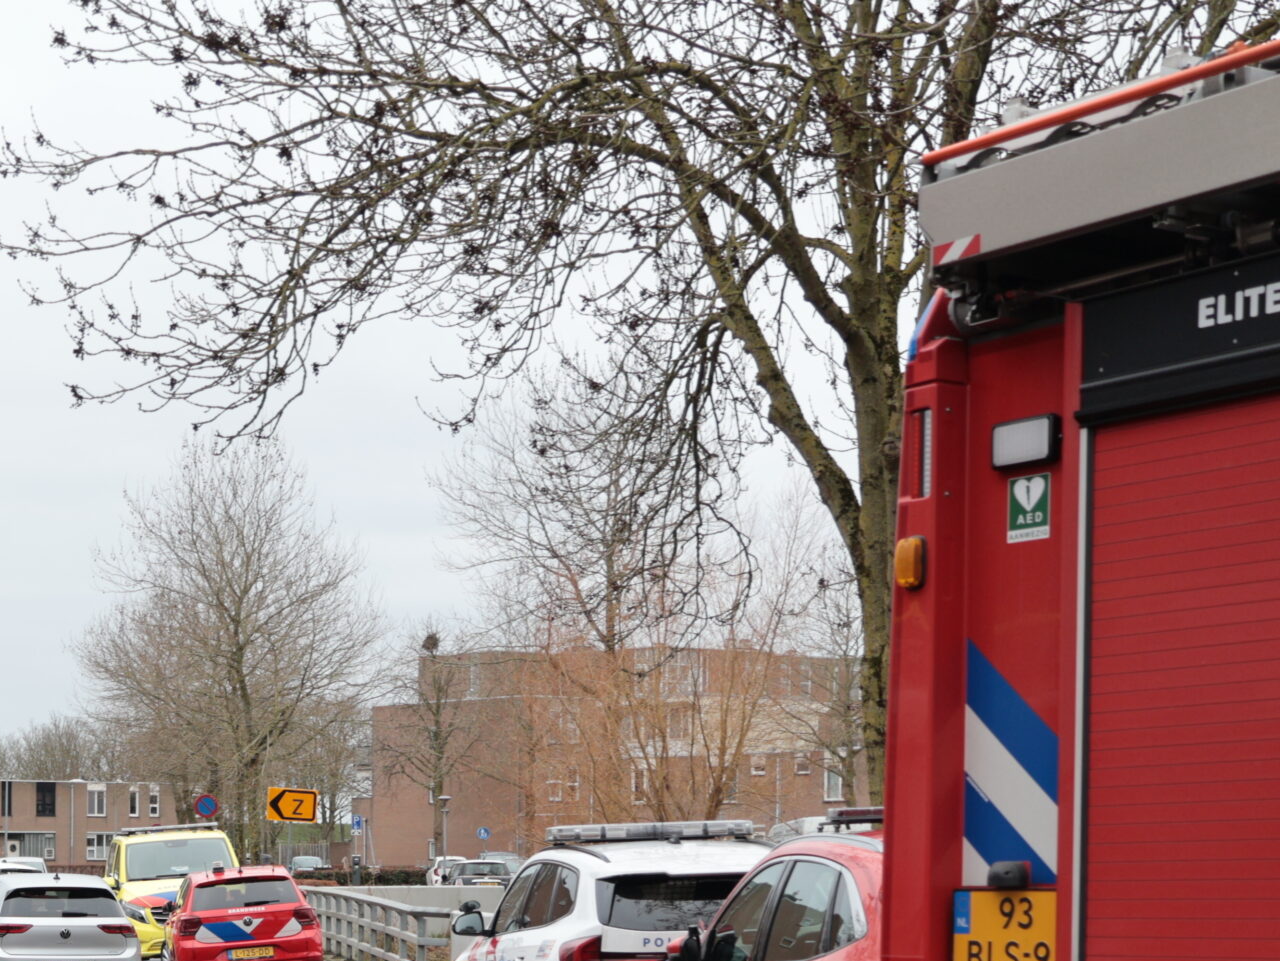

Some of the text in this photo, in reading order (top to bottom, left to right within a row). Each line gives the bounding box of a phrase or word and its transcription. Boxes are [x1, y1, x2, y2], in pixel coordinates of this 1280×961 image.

[1197, 281, 1280, 329] ELITE
[1016, 511, 1043, 526] AED
[292, 798, 304, 816] Z
[999, 896, 1033, 930] 93
